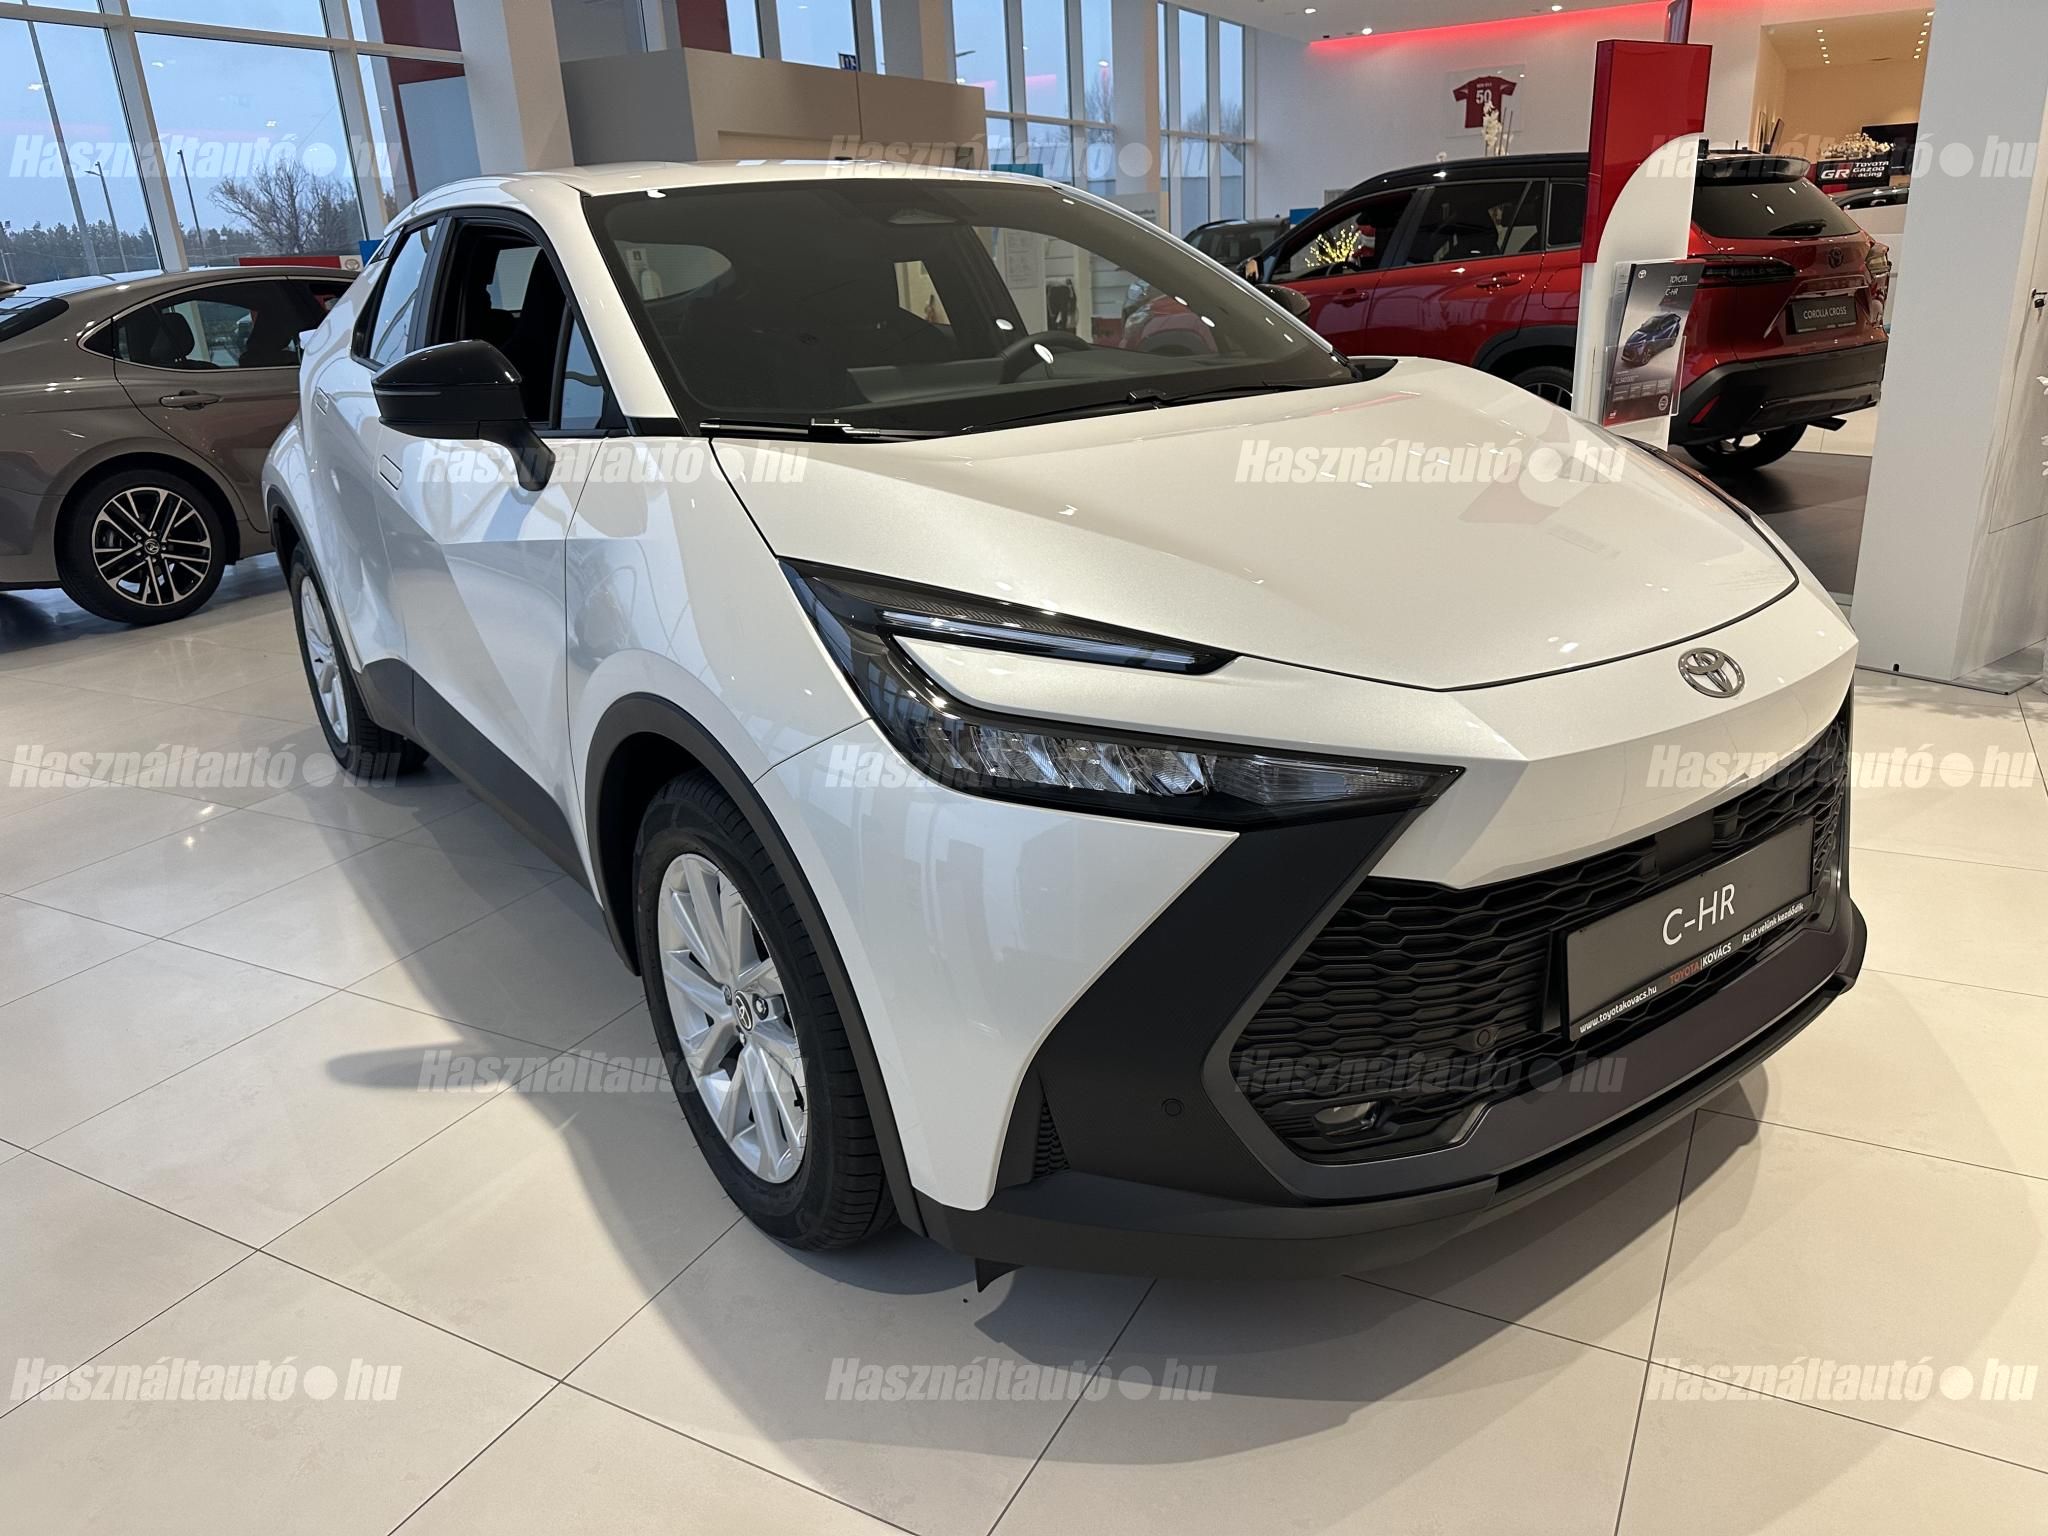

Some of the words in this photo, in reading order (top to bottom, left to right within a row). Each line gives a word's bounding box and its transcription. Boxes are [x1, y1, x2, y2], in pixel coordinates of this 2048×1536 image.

[1476, 89, 1492, 104] 50
[1820, 169, 1850, 179] GR
[1665, 288, 1678, 296] C-HR
[1803, 309, 1828, 319] COROLLA
[1829, 306, 1847, 316] CROSS
[1662, 883, 1735, 946] C-HR
[1579, 986, 1657, 1034] www.toyotakovacs.hu
[1742, 933, 1751, 944] Az
[1758, 916, 1777, 934] velünk
